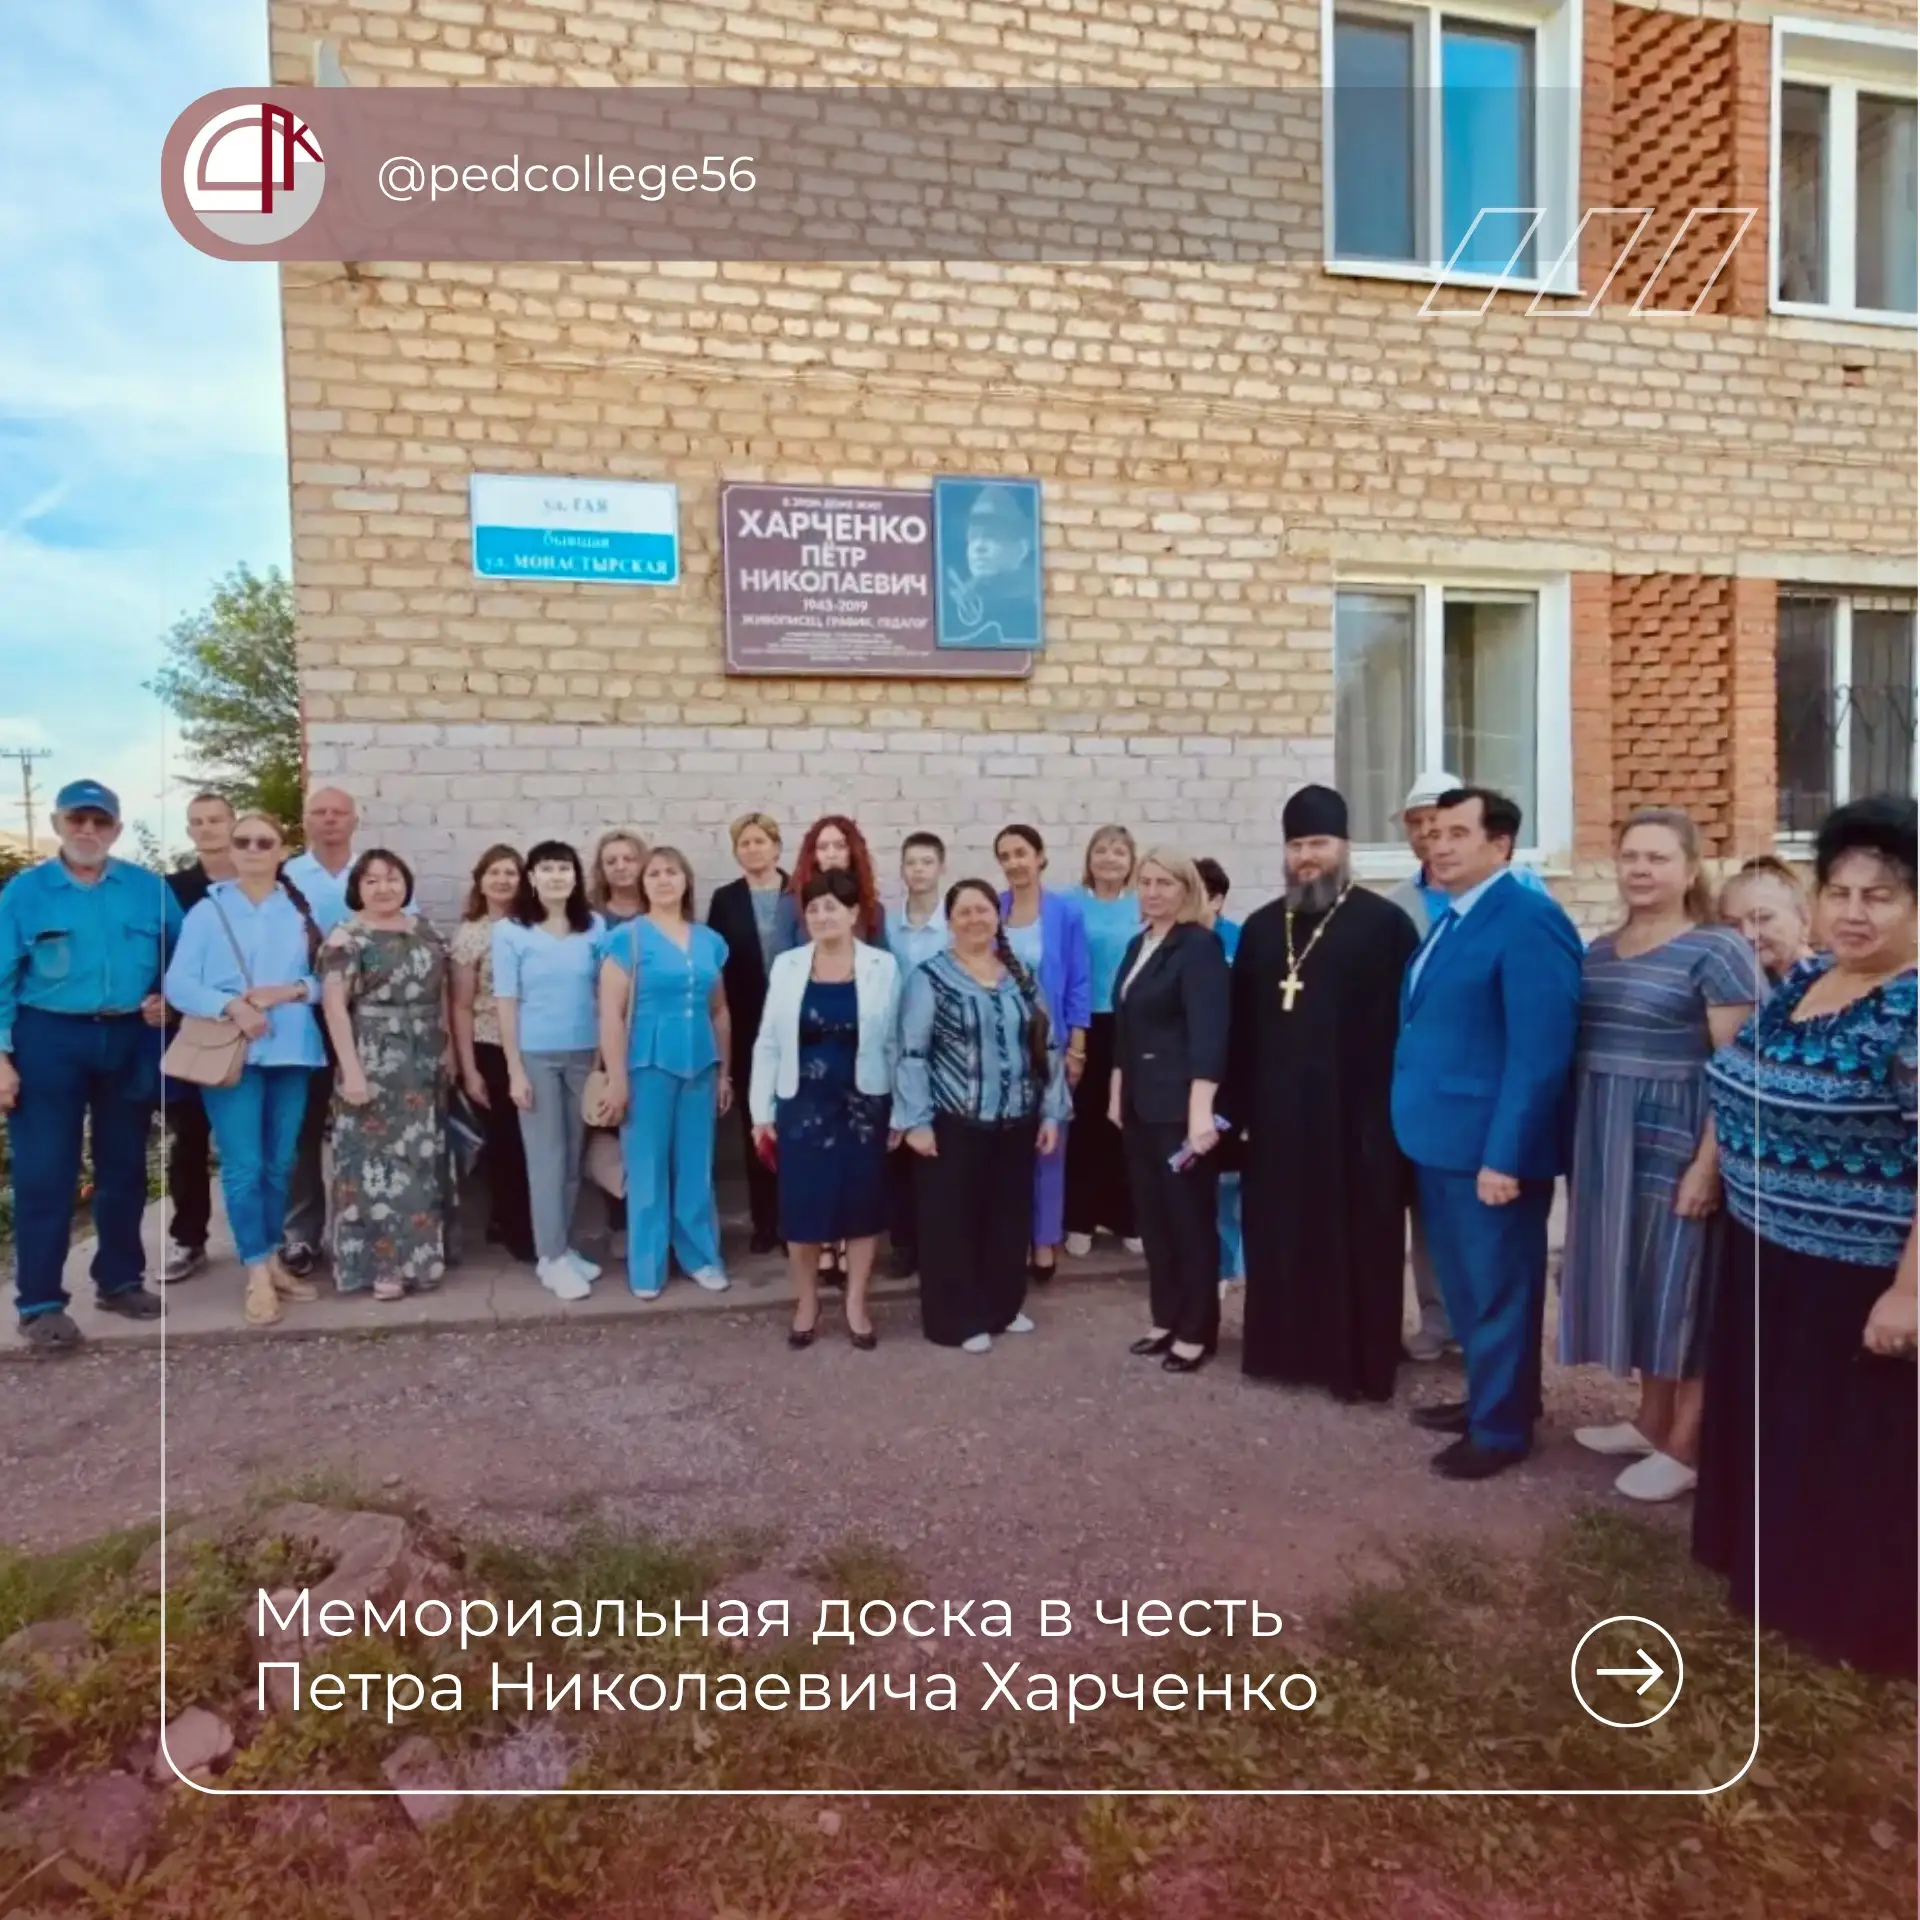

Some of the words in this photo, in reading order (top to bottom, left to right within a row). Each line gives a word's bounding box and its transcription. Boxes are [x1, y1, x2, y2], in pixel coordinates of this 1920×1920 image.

[573, 498, 609, 513] ГАЯ
[737, 509, 927, 543] ХАРЧЕНКО
[513, 553, 668, 575] МОНАСТЫРСКАЯ
[740, 569, 928, 596] НИКОЛАЕВИЧ
